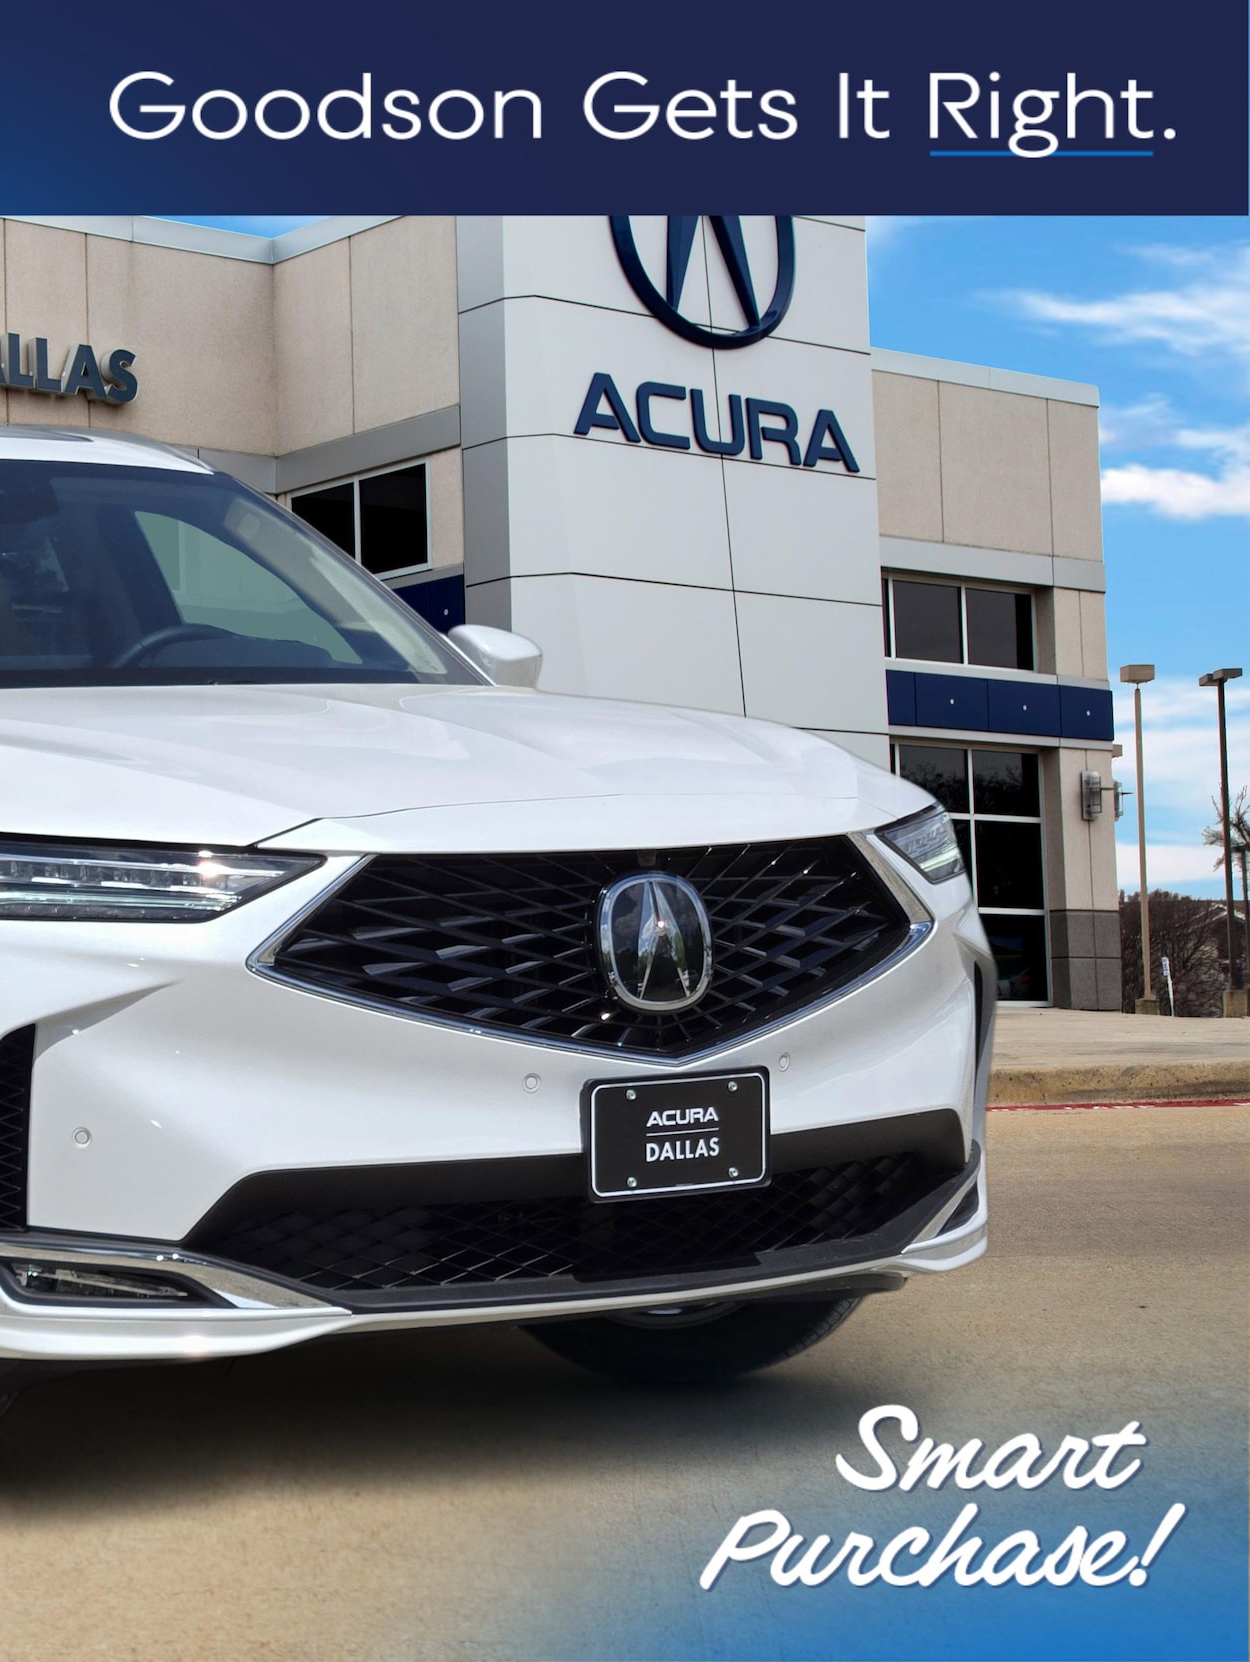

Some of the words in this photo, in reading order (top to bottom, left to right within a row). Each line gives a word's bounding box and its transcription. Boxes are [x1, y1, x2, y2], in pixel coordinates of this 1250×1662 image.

[573, 372, 860, 475] ACURA
[646, 1106, 720, 1127] ACURA
[646, 1137, 720, 1162] DALLAS
